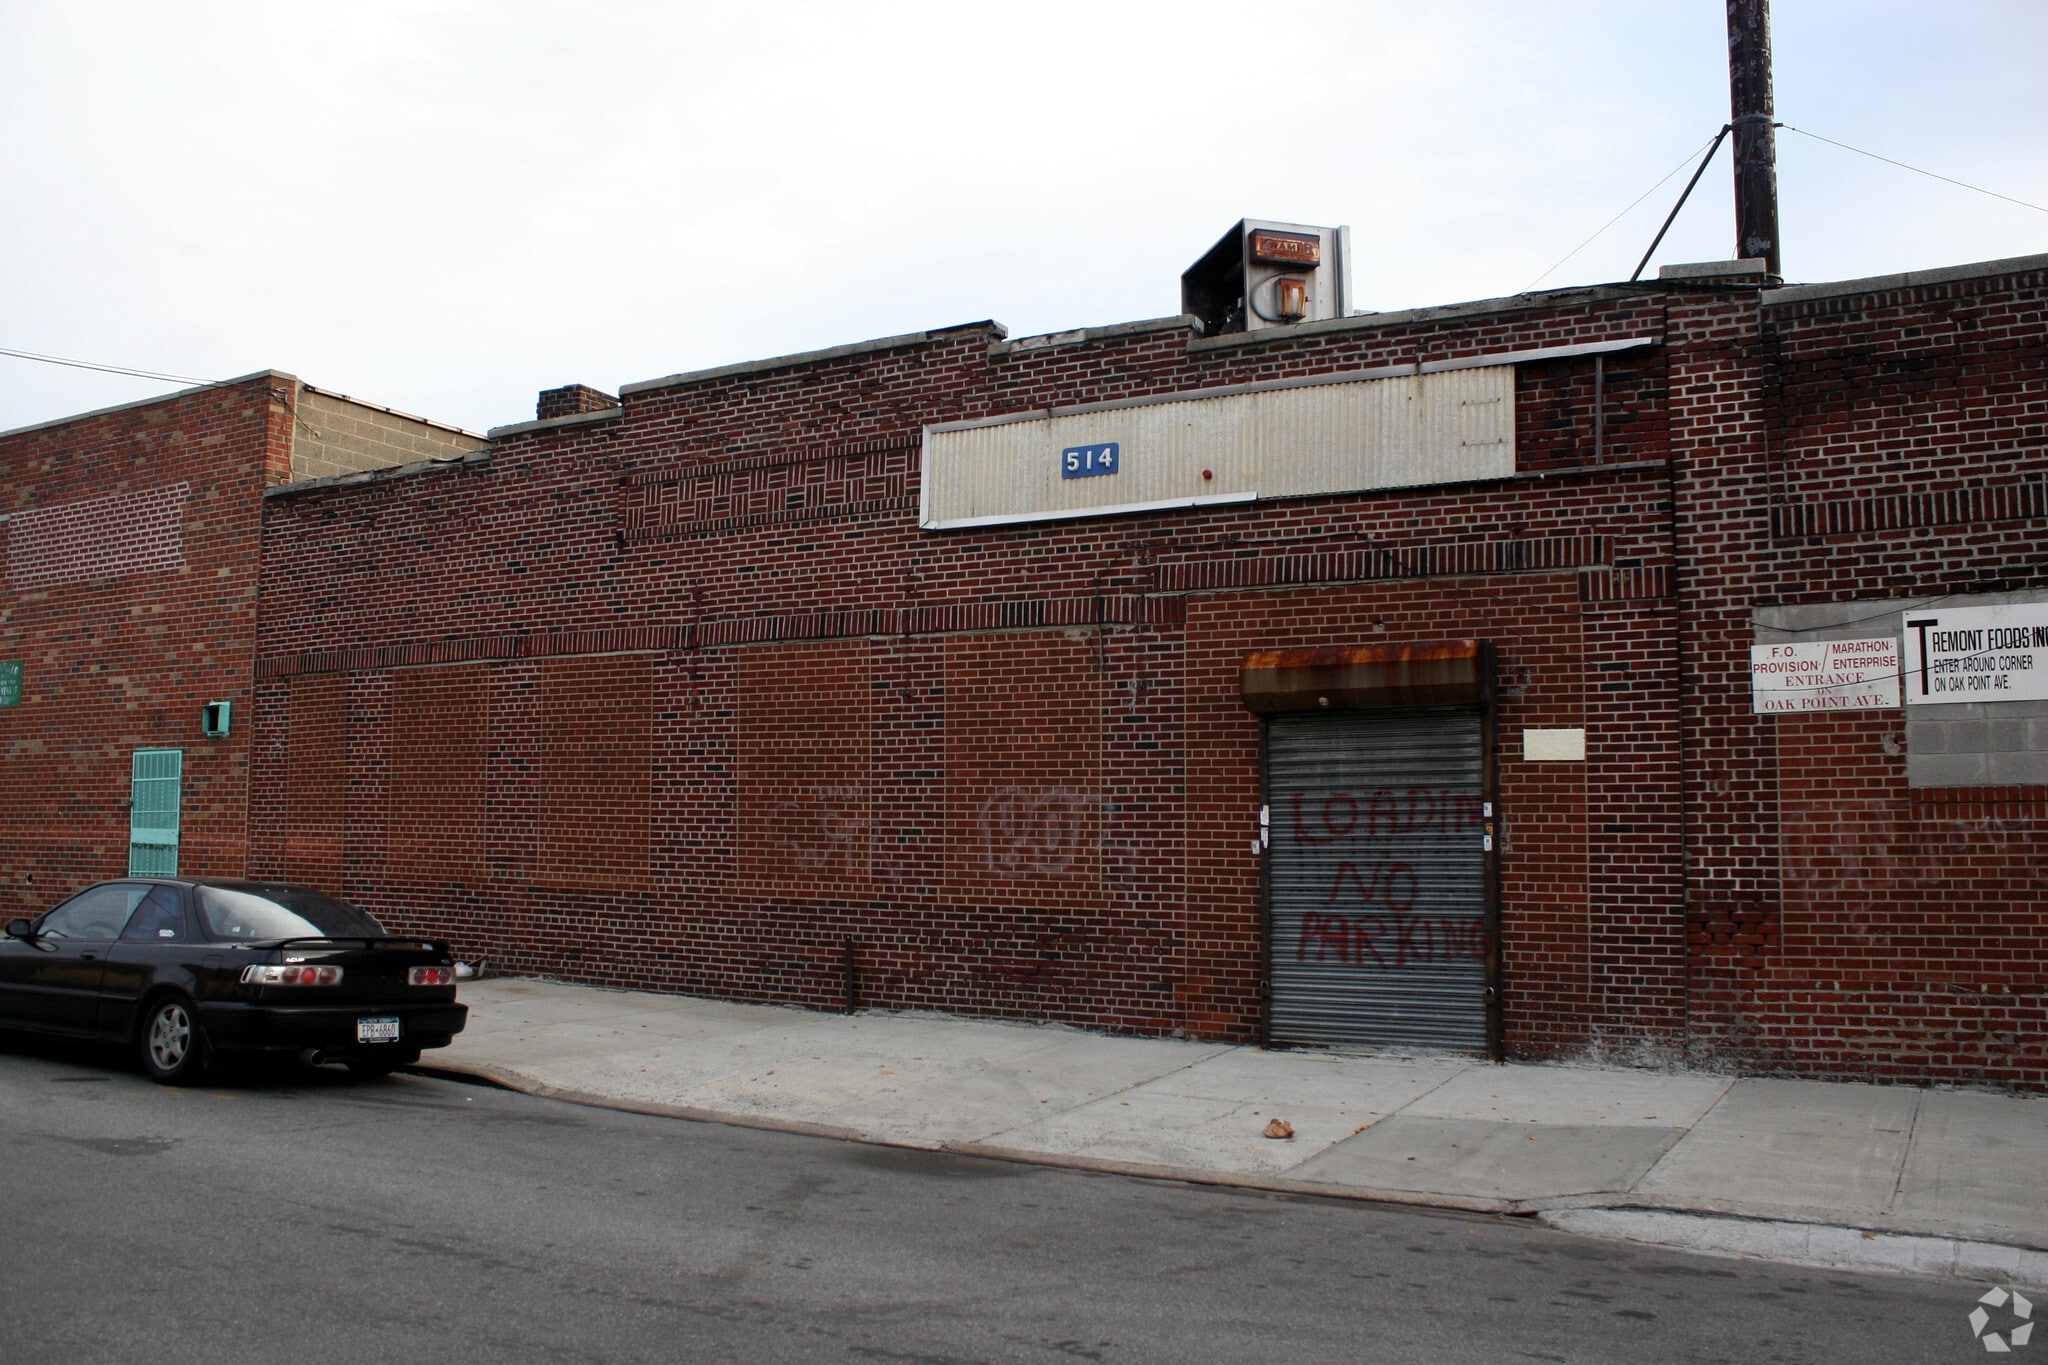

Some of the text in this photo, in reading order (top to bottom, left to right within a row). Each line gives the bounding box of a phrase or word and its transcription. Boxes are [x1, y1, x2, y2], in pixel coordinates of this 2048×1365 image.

[1067, 448, 1113, 471] 514
[1987, 627, 2030, 650] FOODS
[1832, 640, 1889, 654] MARATHON
[1753, 660, 1818, 674] PROVISION
[1833, 656, 1897, 670] ENTERPRISE
[1934, 655, 2033, 674] ENTER AROUND CORNER
[1785, 672, 1865, 687] ENTRANCE
[1934, 674, 2012, 692] ON OAK POINT AVE.
[1817, 687, 1833, 696] ON
[1765, 699, 1796, 711] OAK
[1802, 696, 1849, 709] POINT
[1330, 861, 1418, 912] NO
